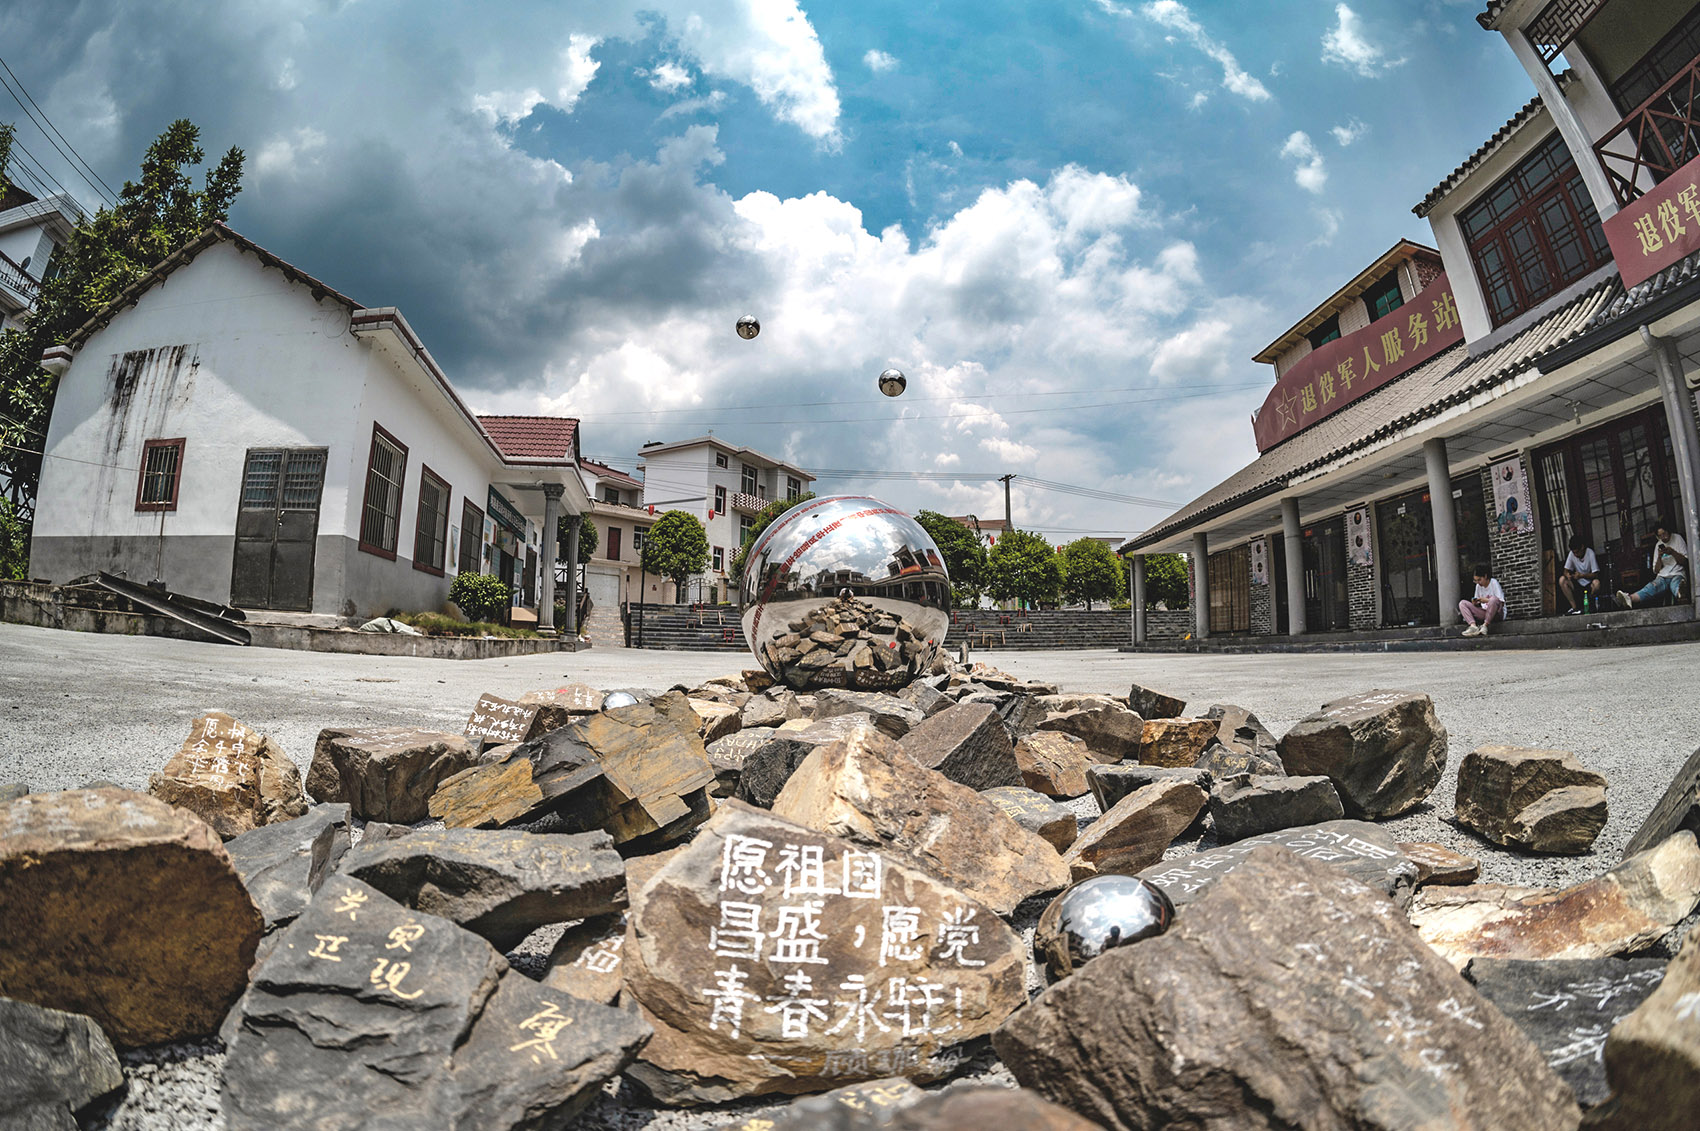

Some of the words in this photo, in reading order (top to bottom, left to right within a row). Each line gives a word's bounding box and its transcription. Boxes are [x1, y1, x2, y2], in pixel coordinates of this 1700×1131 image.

[1633, 183, 1700, 257] 退役军
[1300, 292, 1460, 415] 退役军人服务站
[719, 834, 882, 899] 愿祖国
